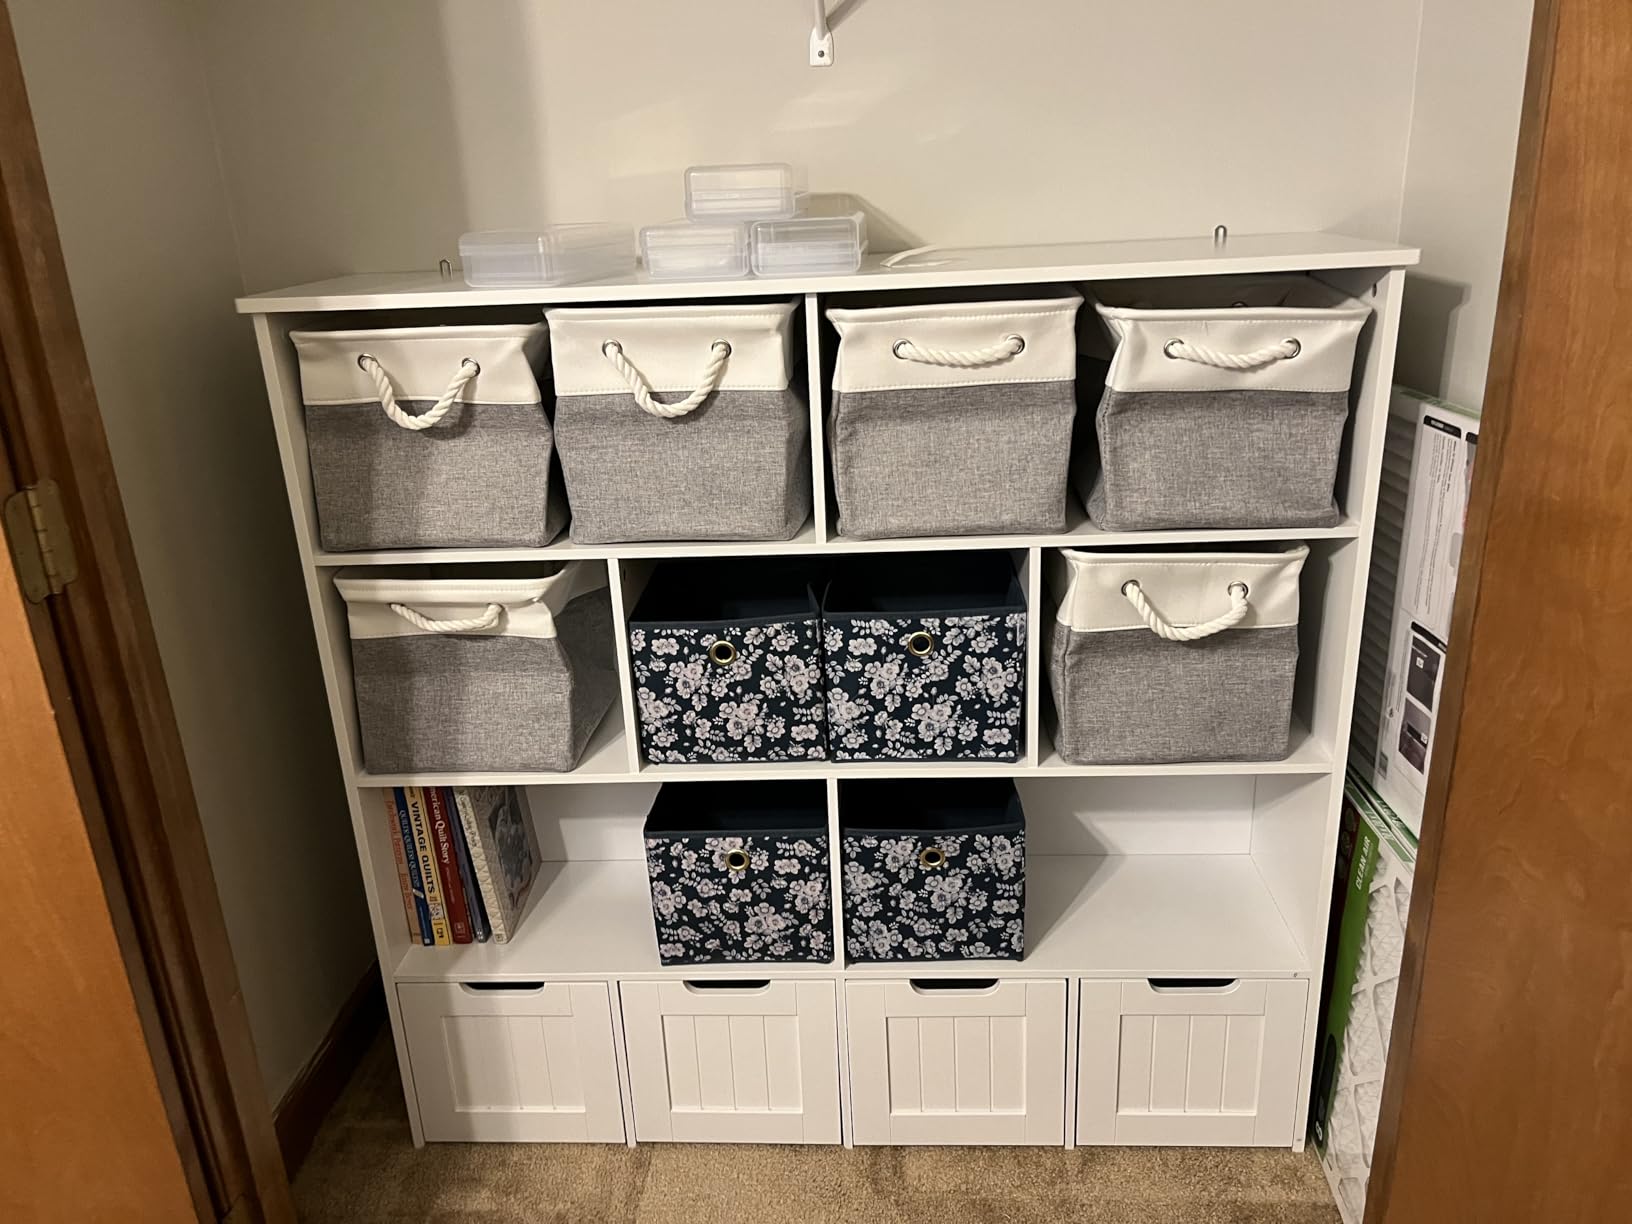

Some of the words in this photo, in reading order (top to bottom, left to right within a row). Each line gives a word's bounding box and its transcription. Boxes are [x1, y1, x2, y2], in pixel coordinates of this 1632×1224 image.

[430, 786, 441, 820] merican
[412, 801, 427, 852] VINTAGE
[421, 855, 435, 894] QUILTS
[435, 821, 448, 842] Quilt
[440, 842, 450, 864] Story
[1356, 855, 1366, 890] CLEAN
[1363, 836, 1371, 857] AIR
